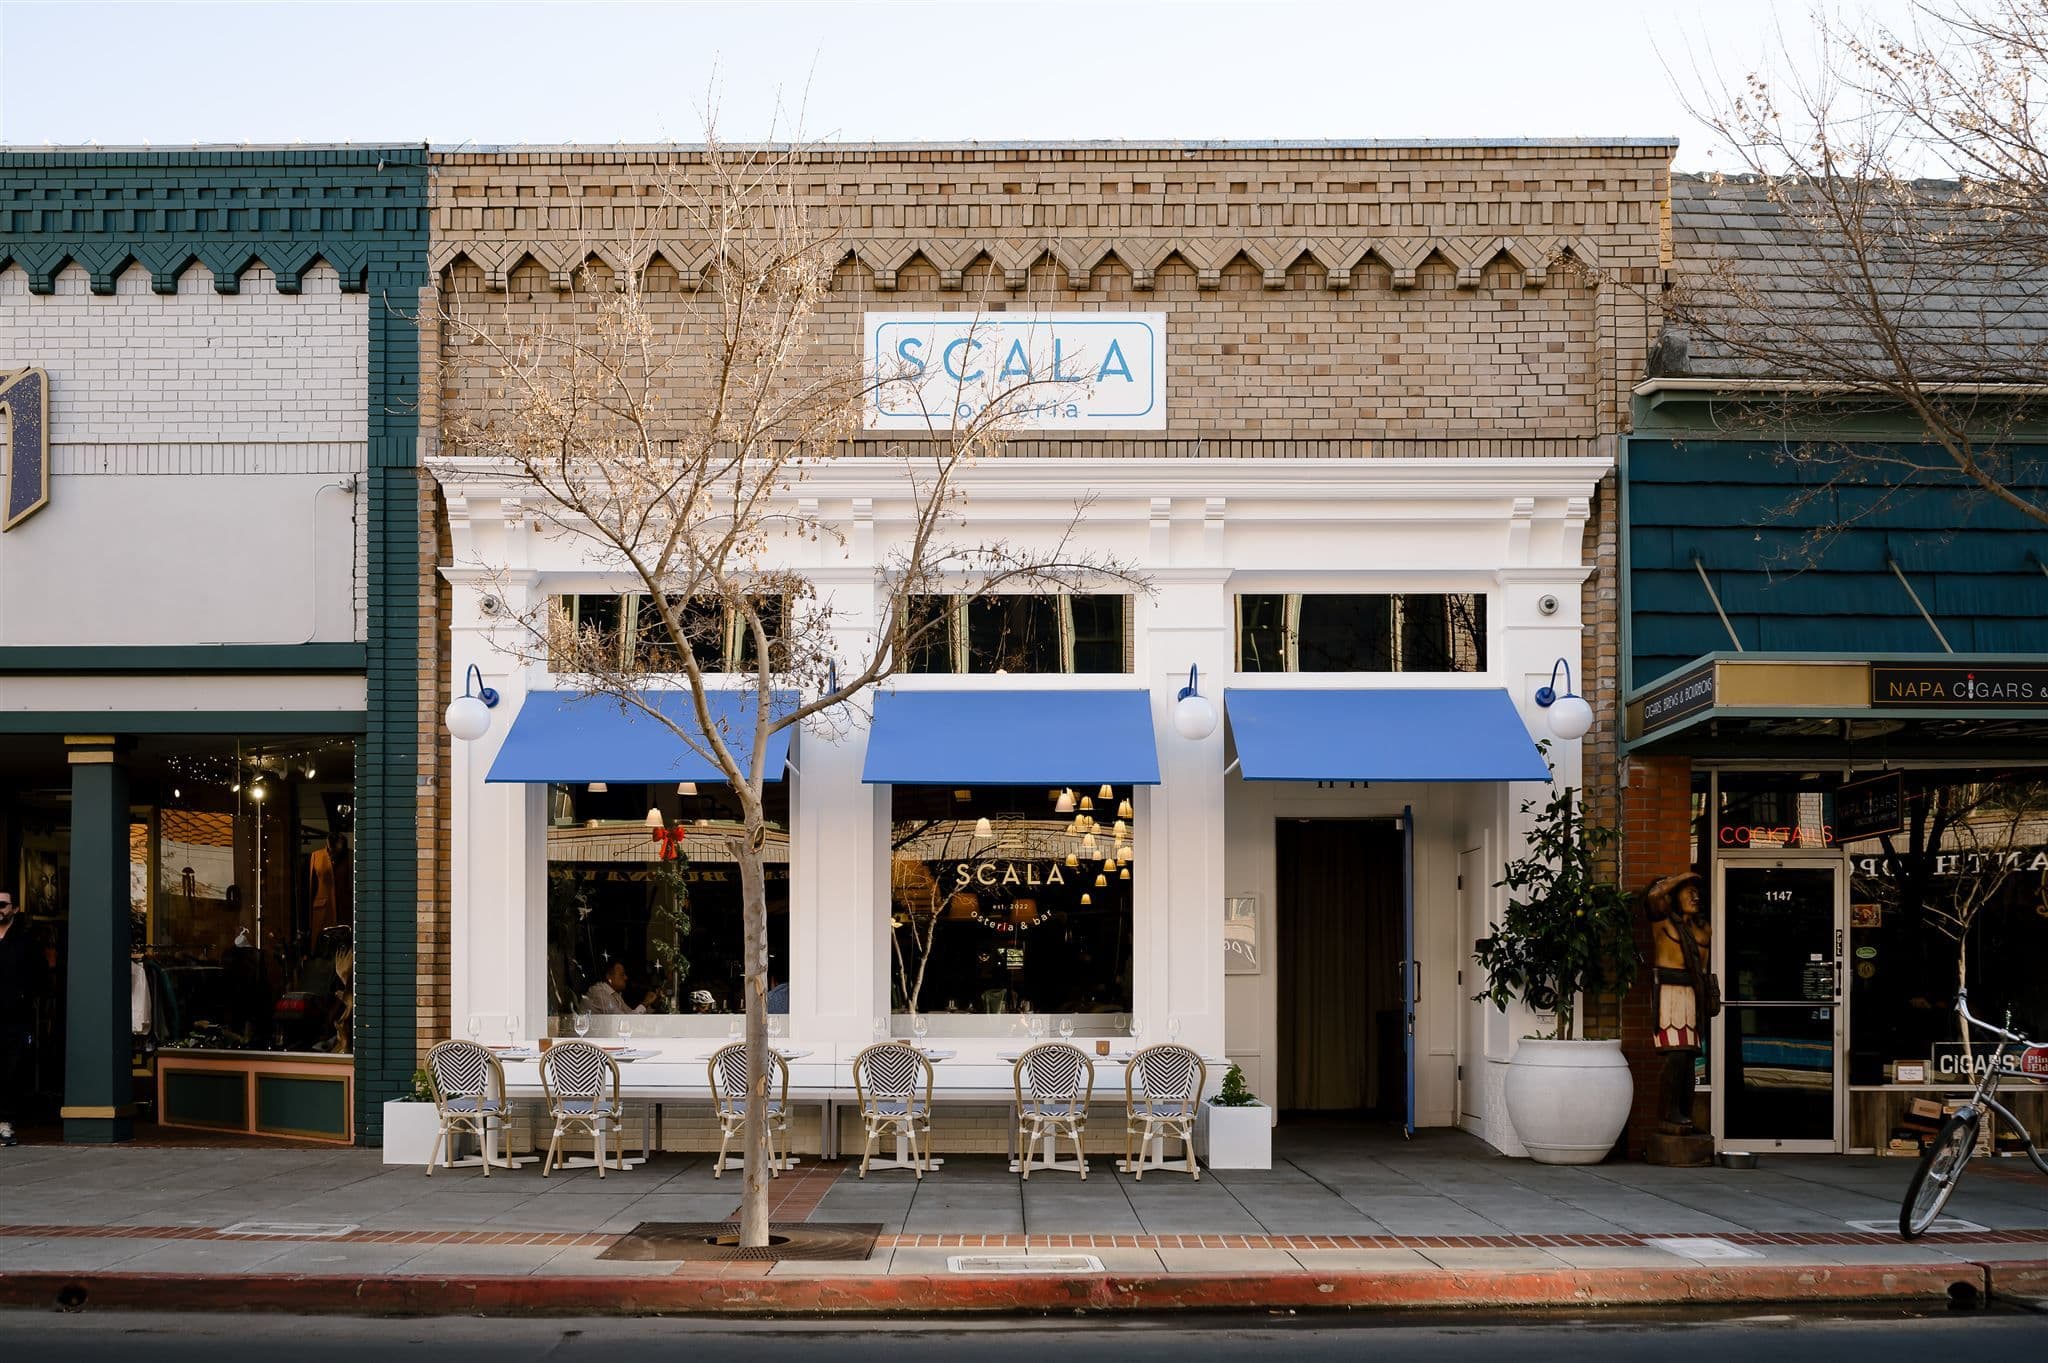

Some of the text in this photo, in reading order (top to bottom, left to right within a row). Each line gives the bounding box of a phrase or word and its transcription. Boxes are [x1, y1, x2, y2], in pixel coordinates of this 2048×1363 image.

[898, 337, 1134, 383] SCALA
[1890, 682, 1945, 697] NAPA
[1720, 825, 1833, 845] COCKTAILS
[956, 863, 1065, 885] SCALA
[1765, 891, 1792, 901] 1147
[971, 909, 1052, 931] osteria & bar
